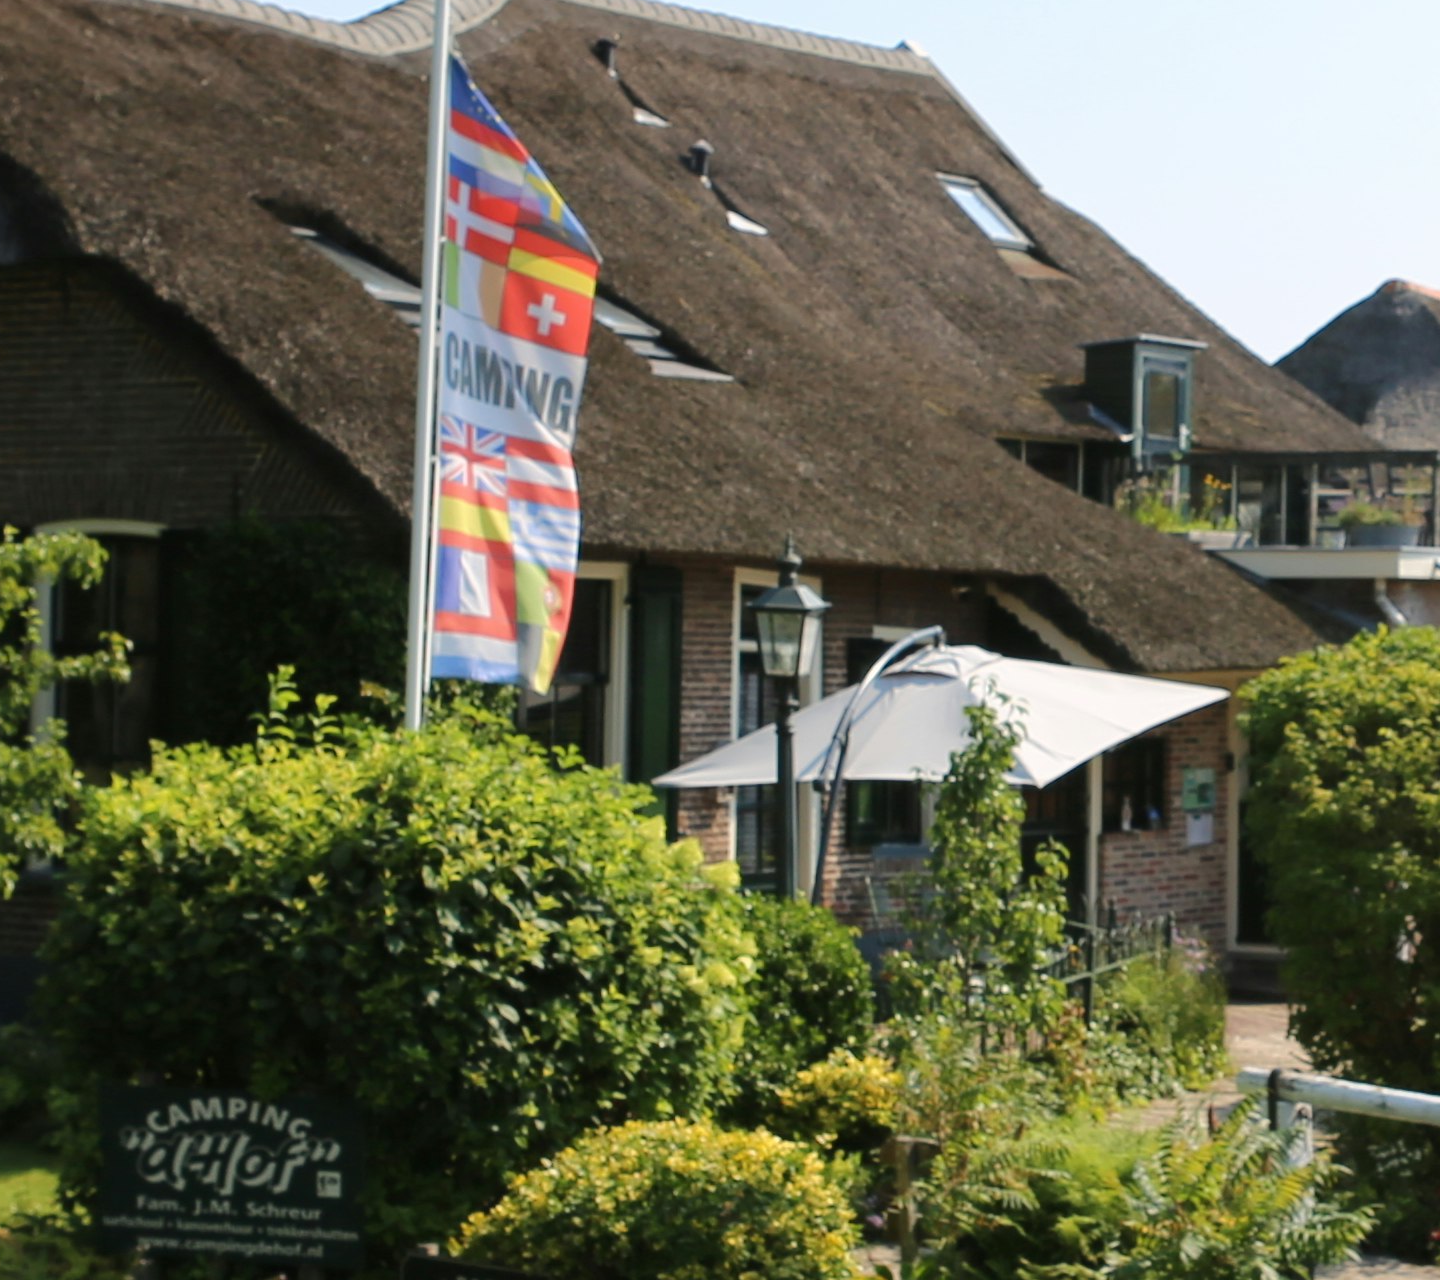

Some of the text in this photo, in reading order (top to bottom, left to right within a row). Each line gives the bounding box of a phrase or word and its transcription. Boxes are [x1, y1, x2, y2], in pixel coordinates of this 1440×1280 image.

[146, 1096, 312, 1139] CAMPING
[136, 1194, 322, 1221] Fam. J.M. Schreur
